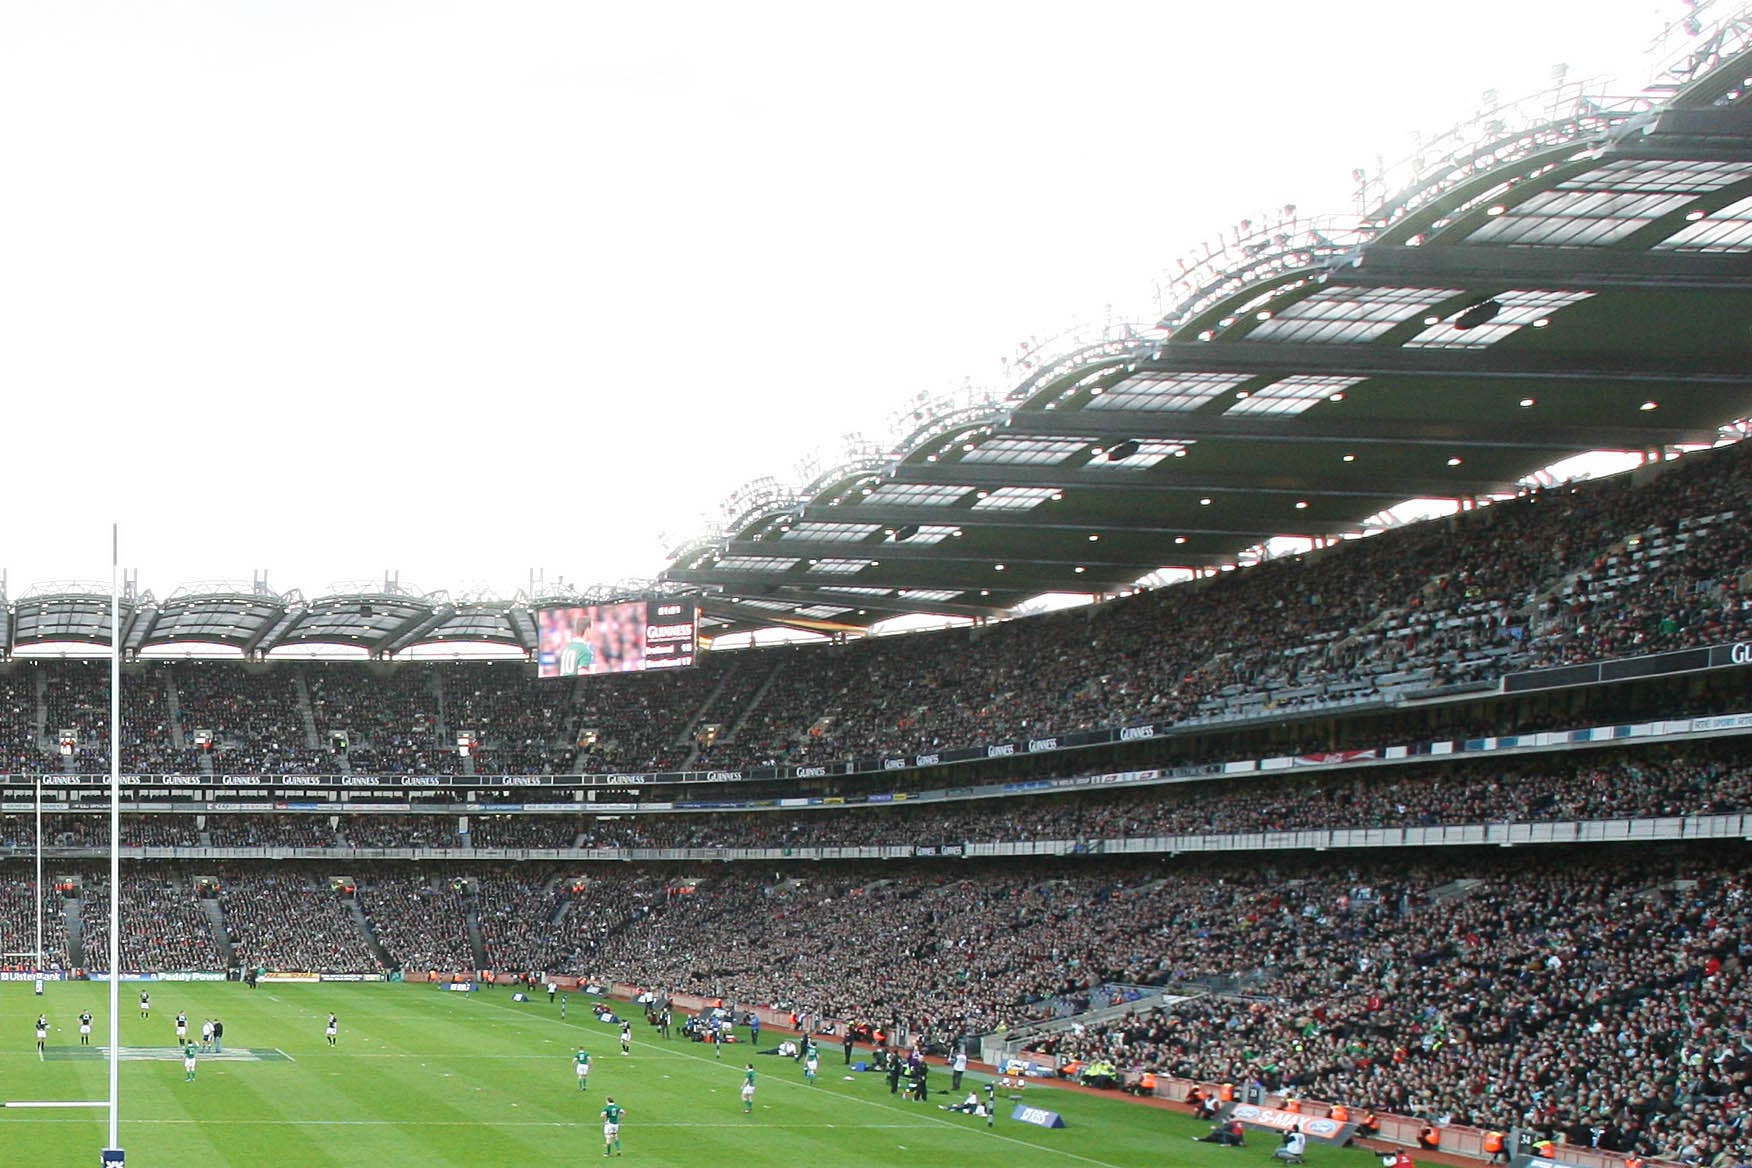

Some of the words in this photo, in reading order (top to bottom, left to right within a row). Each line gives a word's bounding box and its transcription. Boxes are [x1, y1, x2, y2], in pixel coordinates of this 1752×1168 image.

[1120, 726, 1154, 741] GUINNESS
[1028, 738, 1057, 752] GUINNESS
[43, 775, 80, 784] GUINNESS
[162, 775, 200, 785] GUINNESS
[222, 776, 260, 785] GUINNESS
[282, 776, 320, 785] GUINNESS
[342, 776, 380, 785] GUINNESS
[402, 776, 440, 786] GUINNESS
[502, 776, 540, 786] GUINNESS
[606, 774, 645, 784] GUINNESS
[706, 771, 742, 782] GUINNESS
[10, 973, 36, 981] Ulster
[159, 972, 192, 982] Paddy
[193, 972, 226, 981] Power
